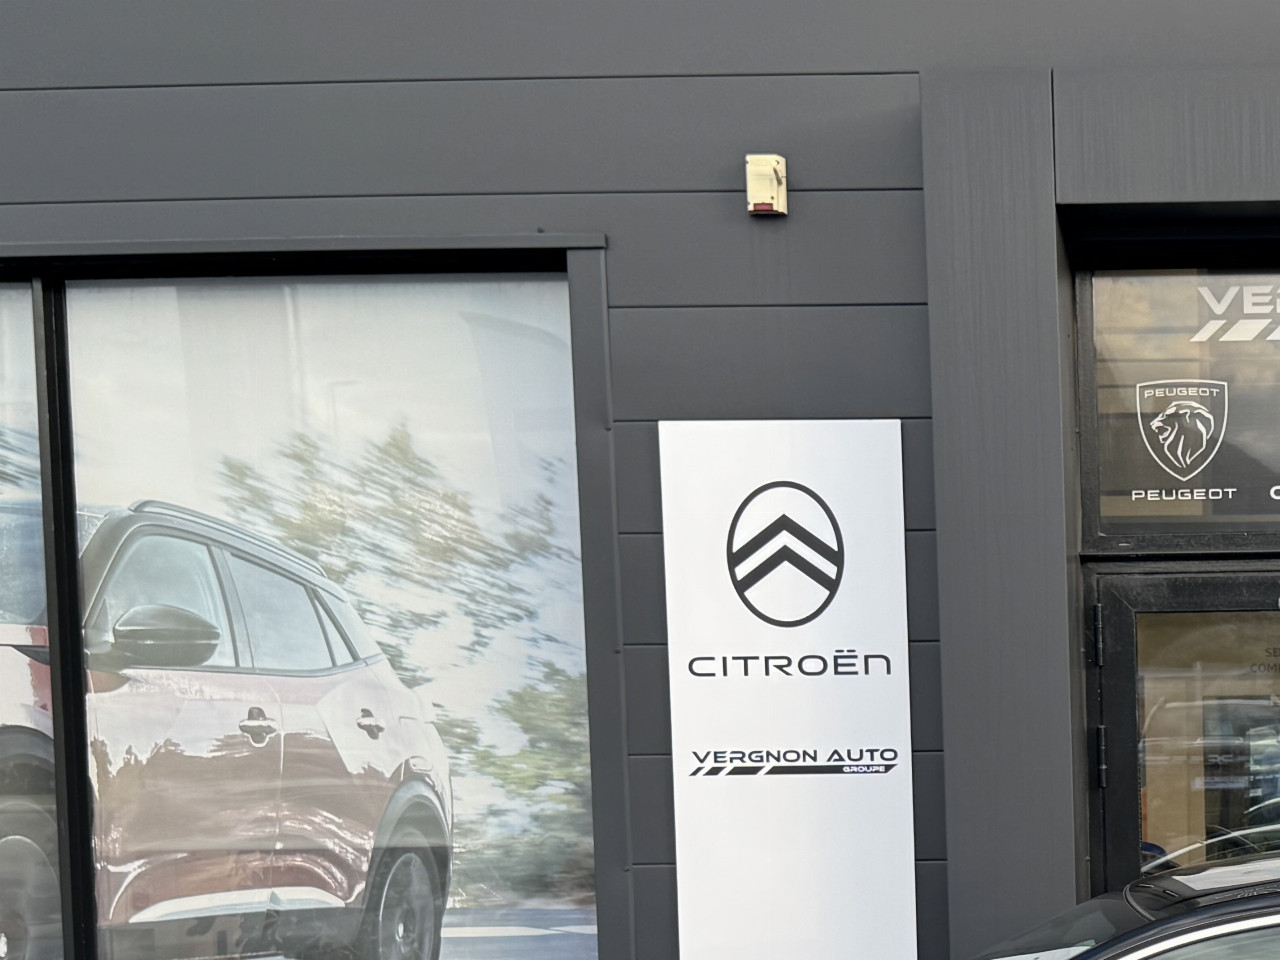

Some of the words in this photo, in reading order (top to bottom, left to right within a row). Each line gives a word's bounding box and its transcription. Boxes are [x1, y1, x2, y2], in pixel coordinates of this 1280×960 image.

[1143, 388, 1220, 399] PEUGEOT
[1131, 488, 1238, 501] PEUGEOT
[688, 649, 892, 677] CITROËN
[692, 750, 818, 763] VERGNON
[826, 748, 898, 762] AUTO
[842, 765, 886, 774] GROUPE
